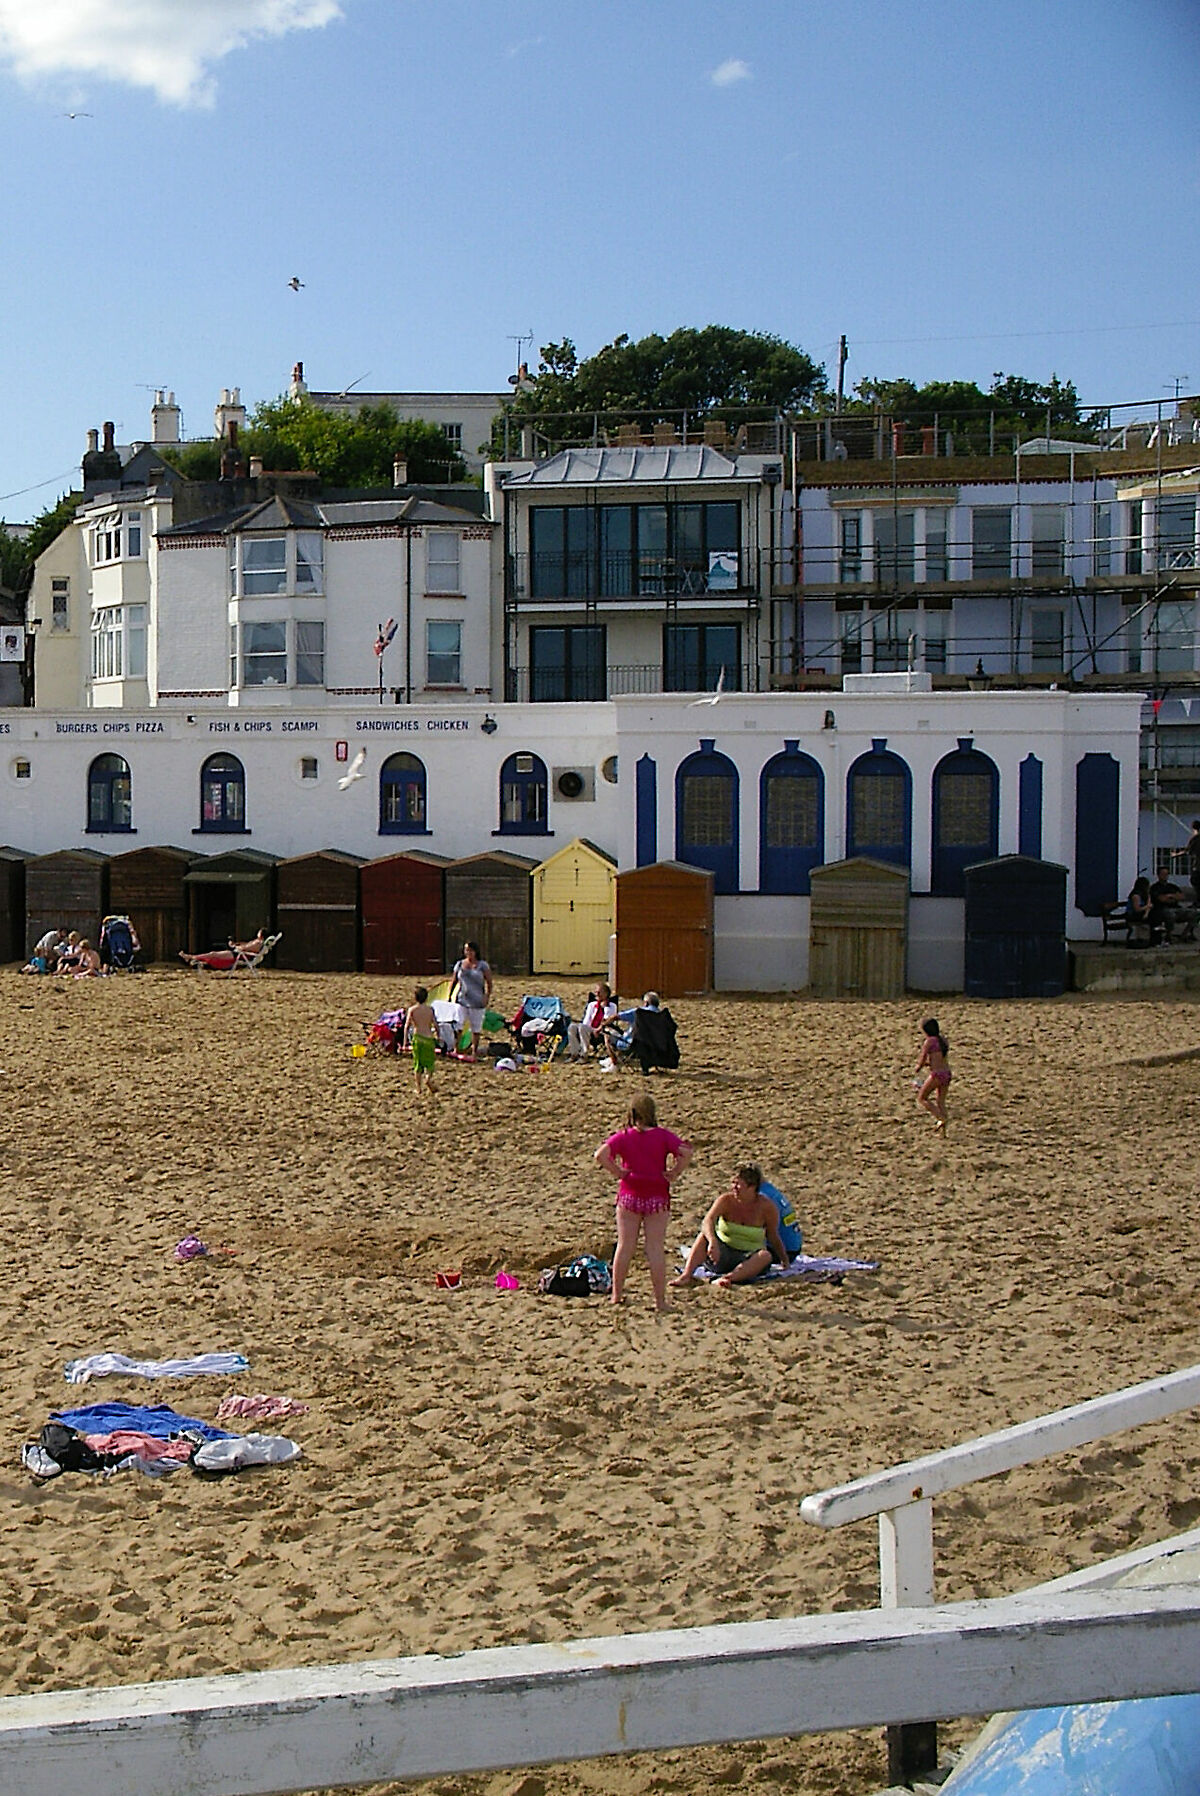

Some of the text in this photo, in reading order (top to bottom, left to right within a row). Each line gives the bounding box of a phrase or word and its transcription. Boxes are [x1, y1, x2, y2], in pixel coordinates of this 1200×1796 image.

[55, 721, 165, 733] BURGERS CHIPS PIZZA
[209, 720, 318, 732] FISH & CHIPS SCAMPI
[356, 718, 470, 731] SANDWICHES CHICKEN
